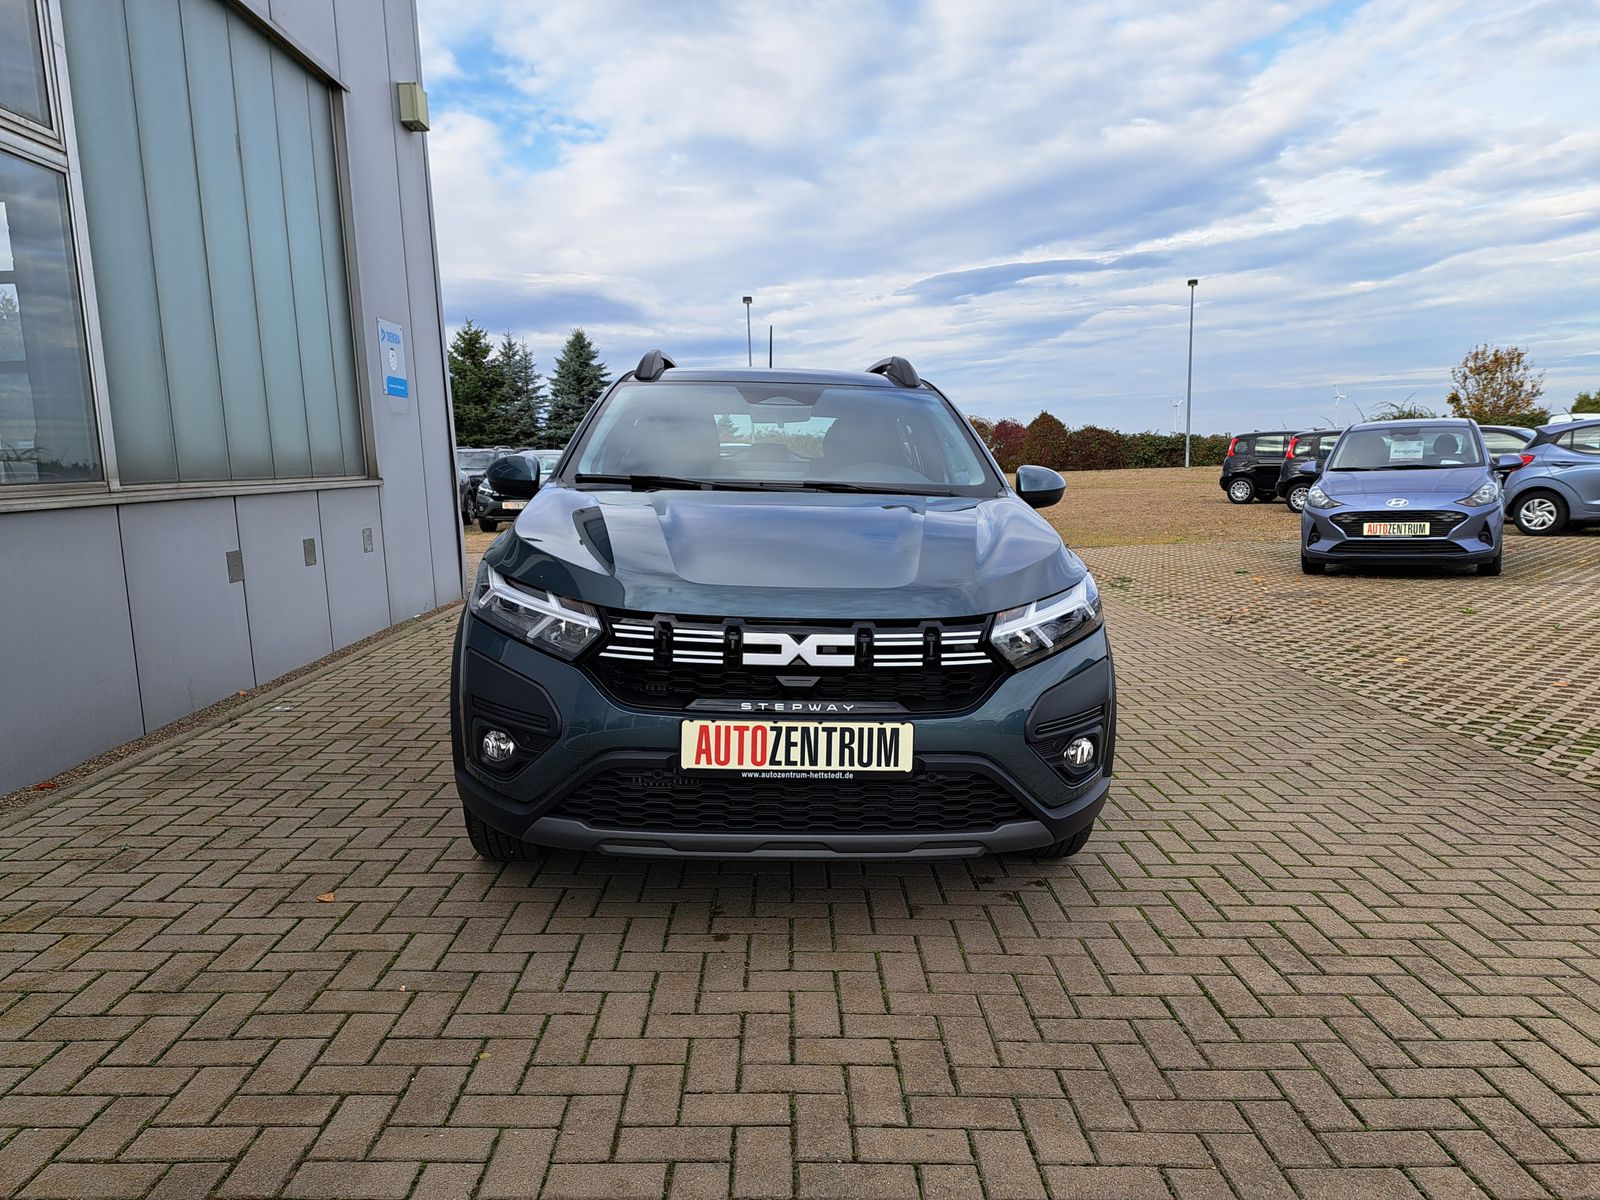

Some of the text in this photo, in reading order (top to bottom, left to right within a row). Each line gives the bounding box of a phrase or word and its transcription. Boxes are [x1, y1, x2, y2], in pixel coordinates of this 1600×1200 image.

[1367, 523, 1426, 535] AUTOZENTRUM
[740, 702, 855, 712] STEPWAY
[694, 724, 900, 767] AUTOZENTRUM
[741, 771, 854, 779] www.autozentrum-hettstedt.de
